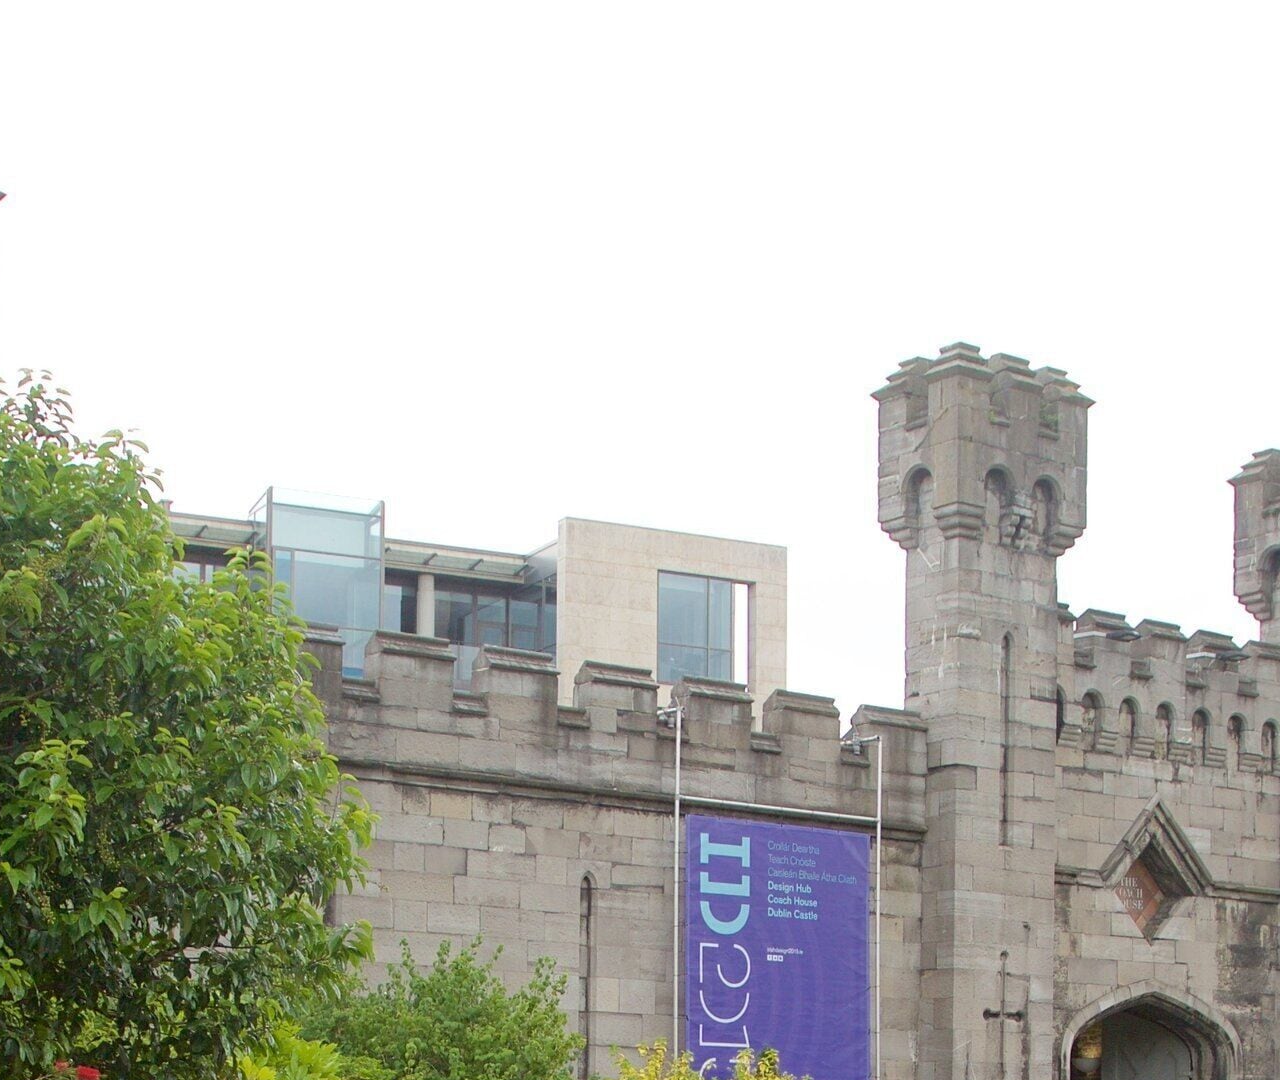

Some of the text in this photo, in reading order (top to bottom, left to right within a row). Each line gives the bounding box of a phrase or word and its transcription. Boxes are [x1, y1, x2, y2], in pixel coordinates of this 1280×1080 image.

[768, 854, 789, 865] Teach
[768, 881, 812, 893] Design Hub
[768, 894, 818, 907] Coach House
[768, 907, 818, 920] Dublin Castle
